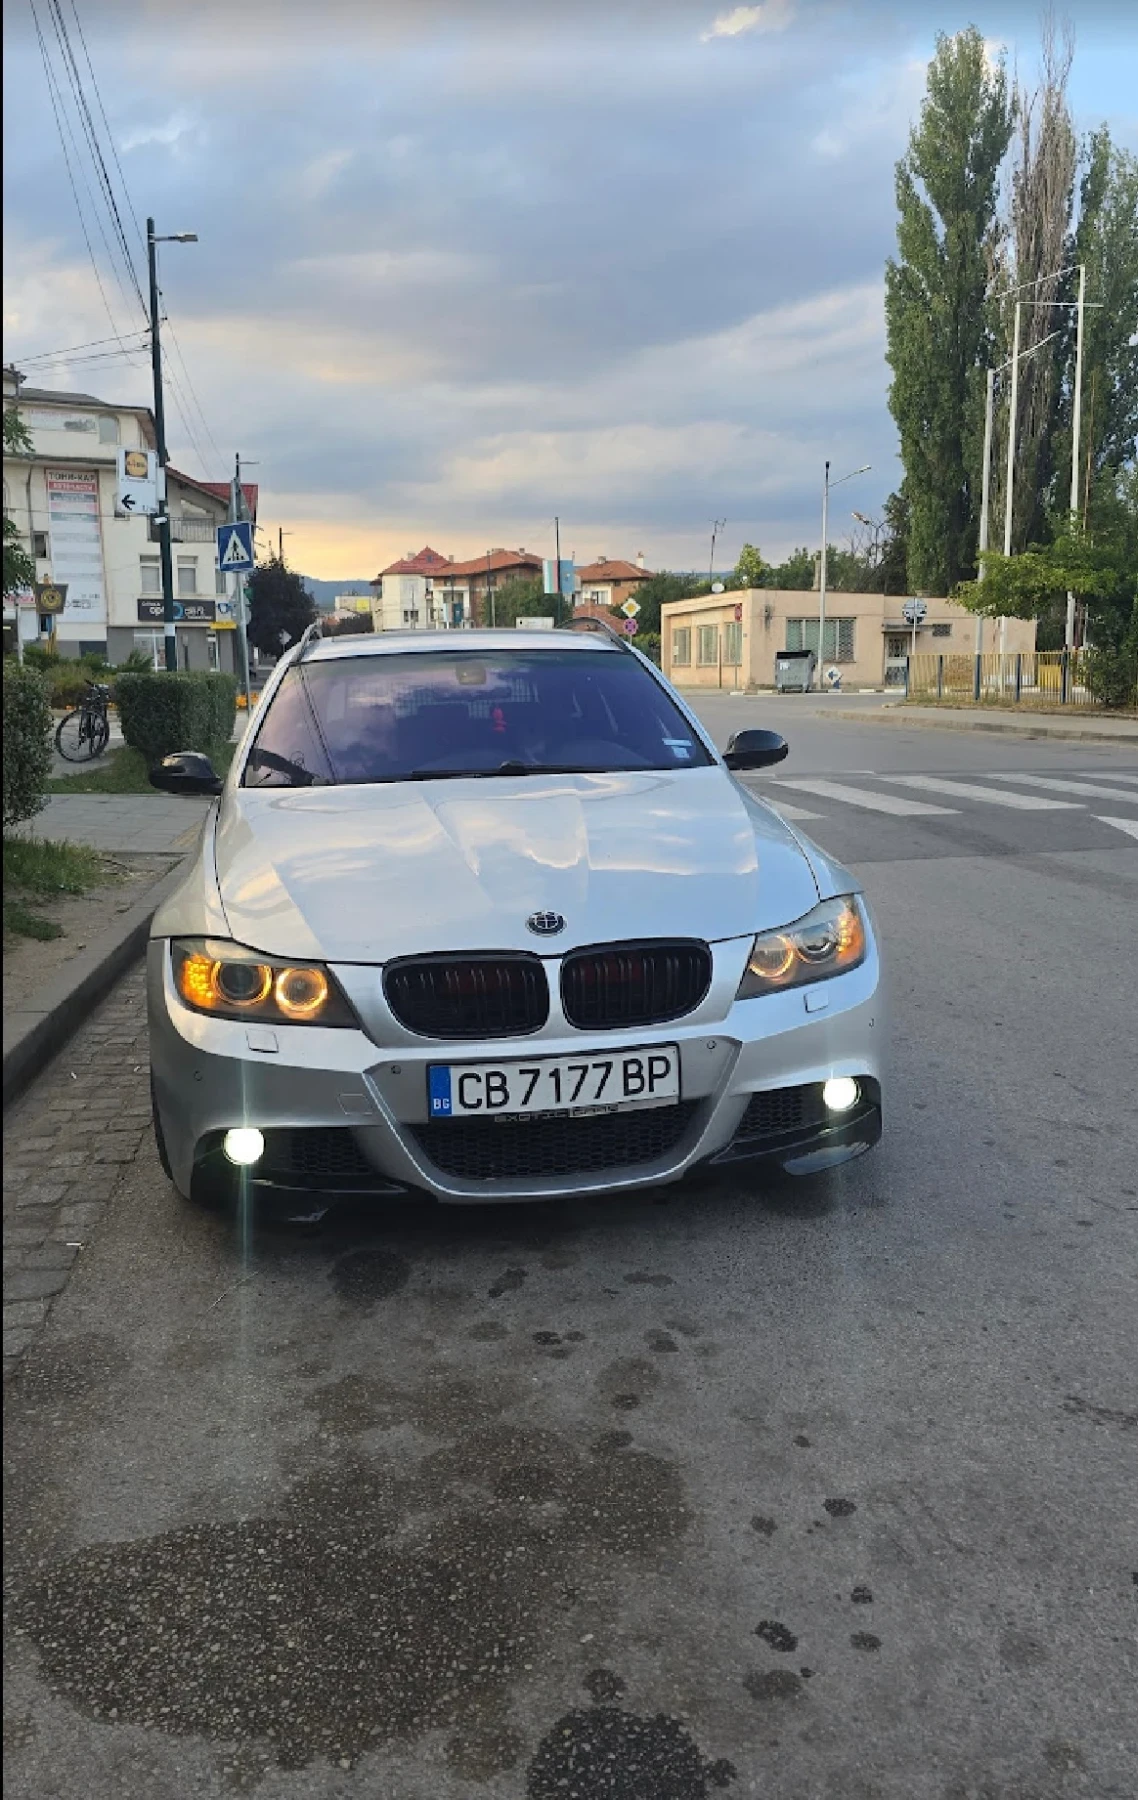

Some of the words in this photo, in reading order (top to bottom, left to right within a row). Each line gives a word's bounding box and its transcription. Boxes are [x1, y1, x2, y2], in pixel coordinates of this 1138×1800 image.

[458, 1071, 510, 1110] CB
[519, 1061, 613, 1106] 7177
[623, 1055, 671, 1097] BP
[433, 1098, 450, 1110] BG
